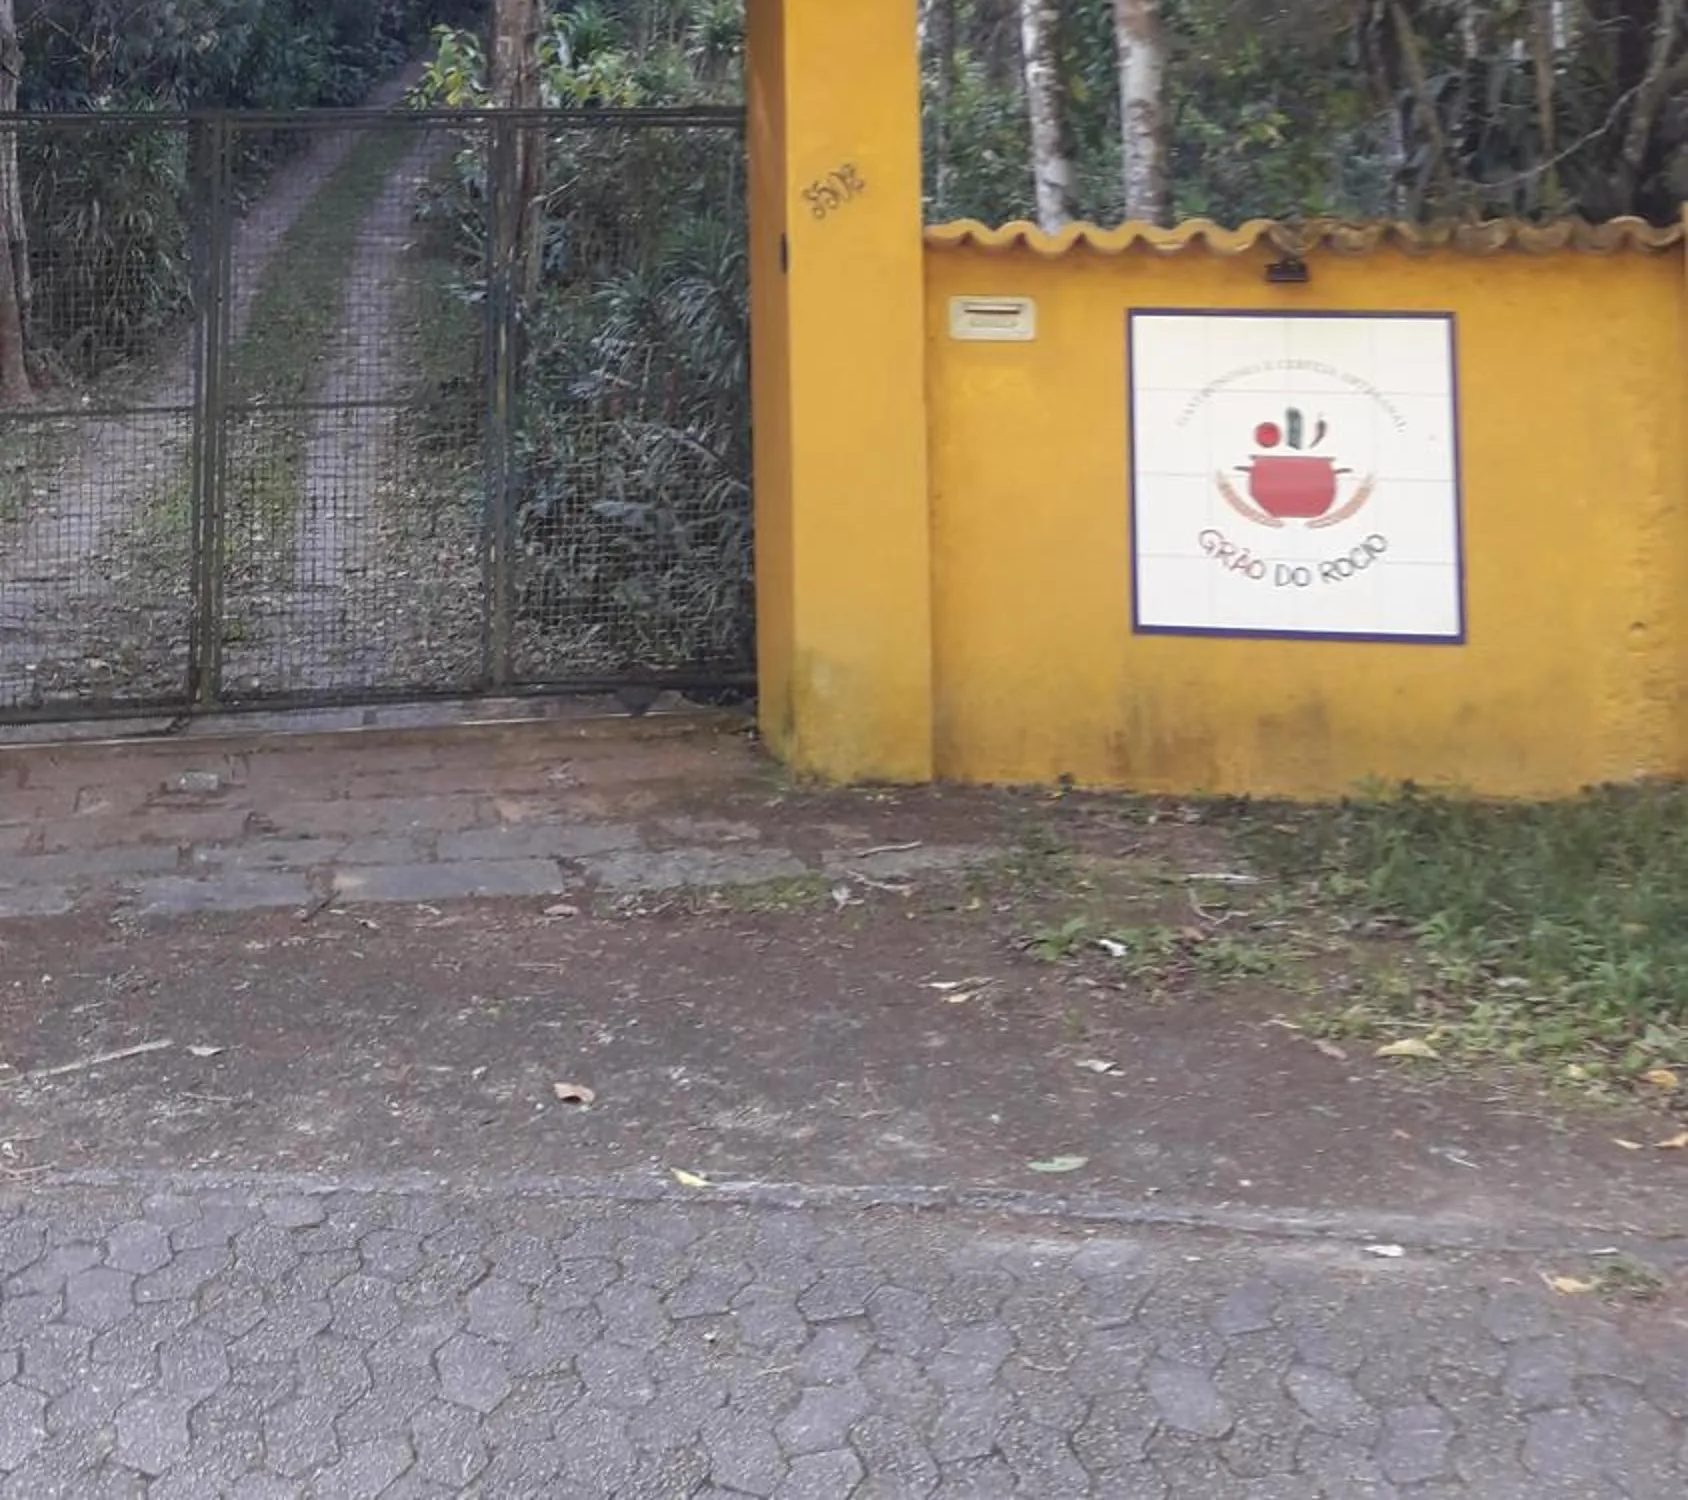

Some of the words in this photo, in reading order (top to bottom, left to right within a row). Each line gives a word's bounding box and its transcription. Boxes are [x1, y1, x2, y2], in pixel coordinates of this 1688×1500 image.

[1199, 529, 1266, 580] GRÃO
[1274, 564, 1312, 587] DO
[1318, 533, 1388, 583] ROCIO
